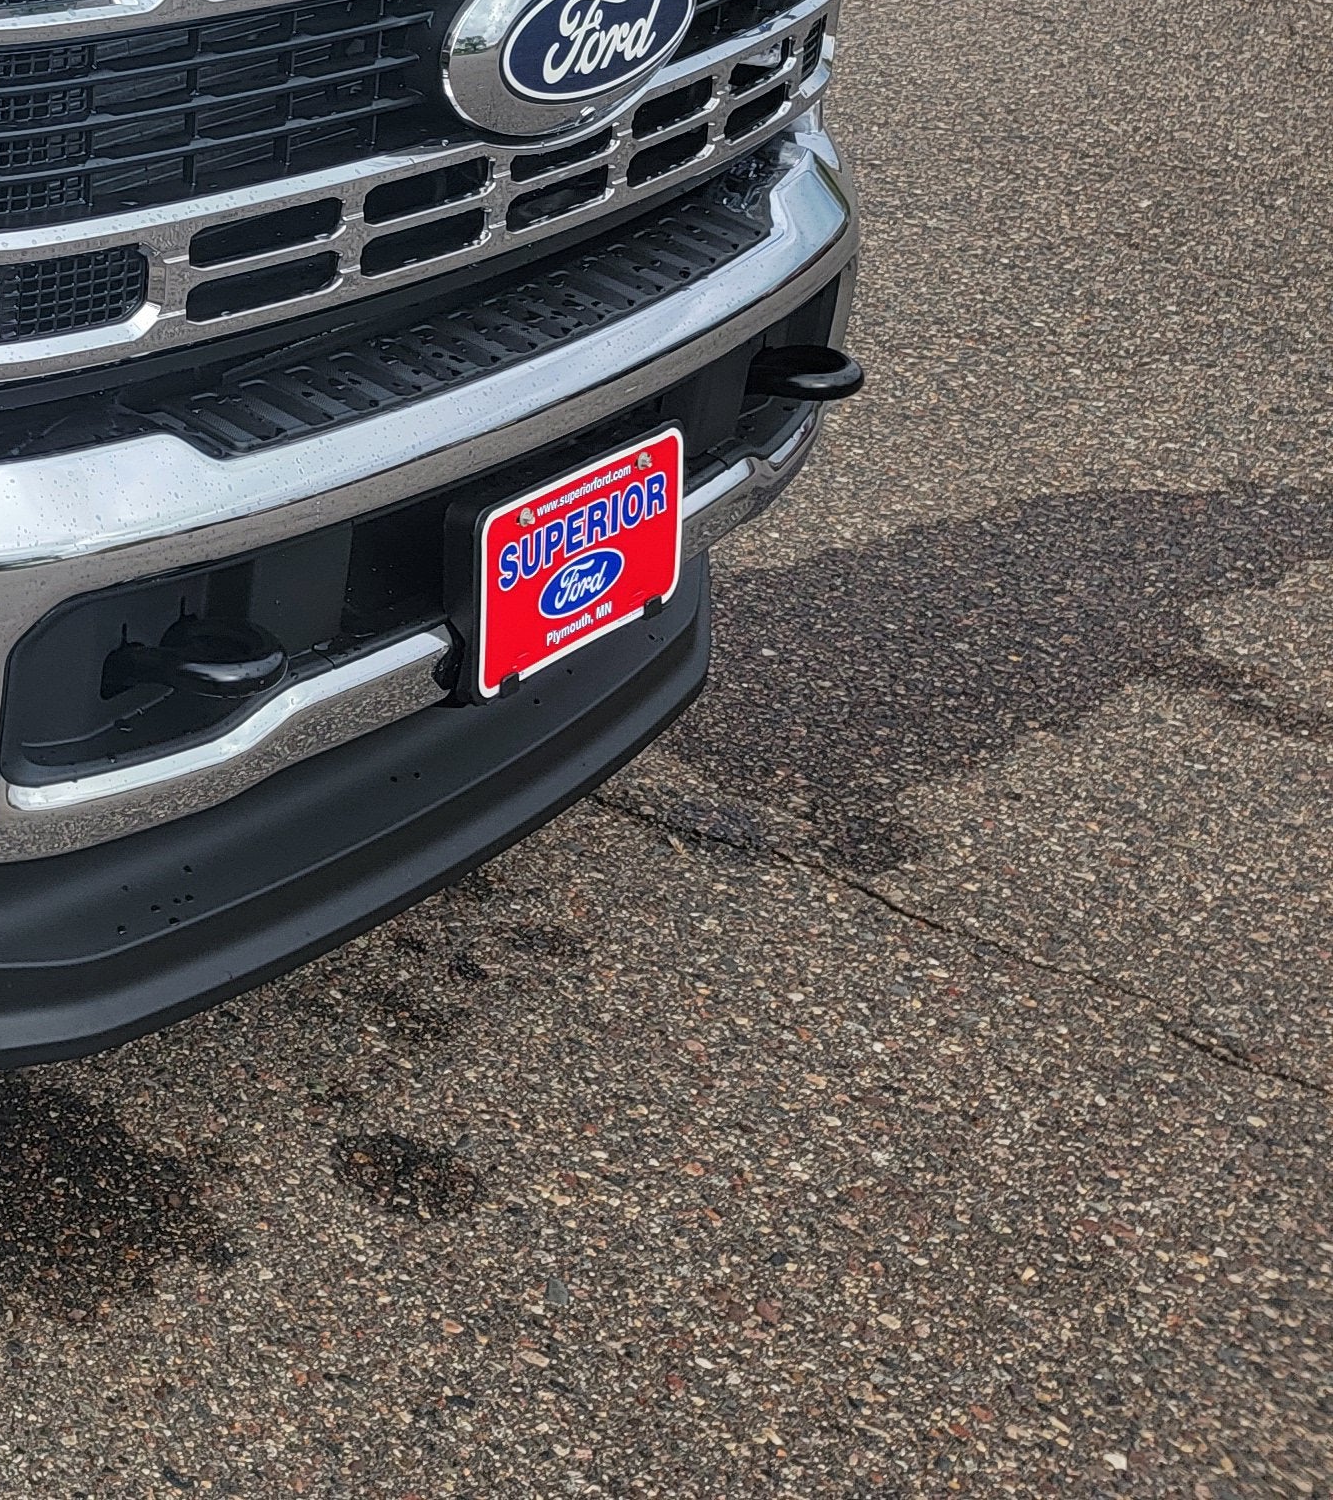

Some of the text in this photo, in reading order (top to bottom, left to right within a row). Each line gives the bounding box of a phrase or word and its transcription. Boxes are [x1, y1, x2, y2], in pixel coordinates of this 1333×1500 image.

[536, 464, 632, 518] www.superiorford.com
[498, 471, 667, 592] SUPERIOR
[555, 559, 608, 610] Ford
[546, 613, 594, 647] Plymouth,
[596, 600, 613, 622] MN
